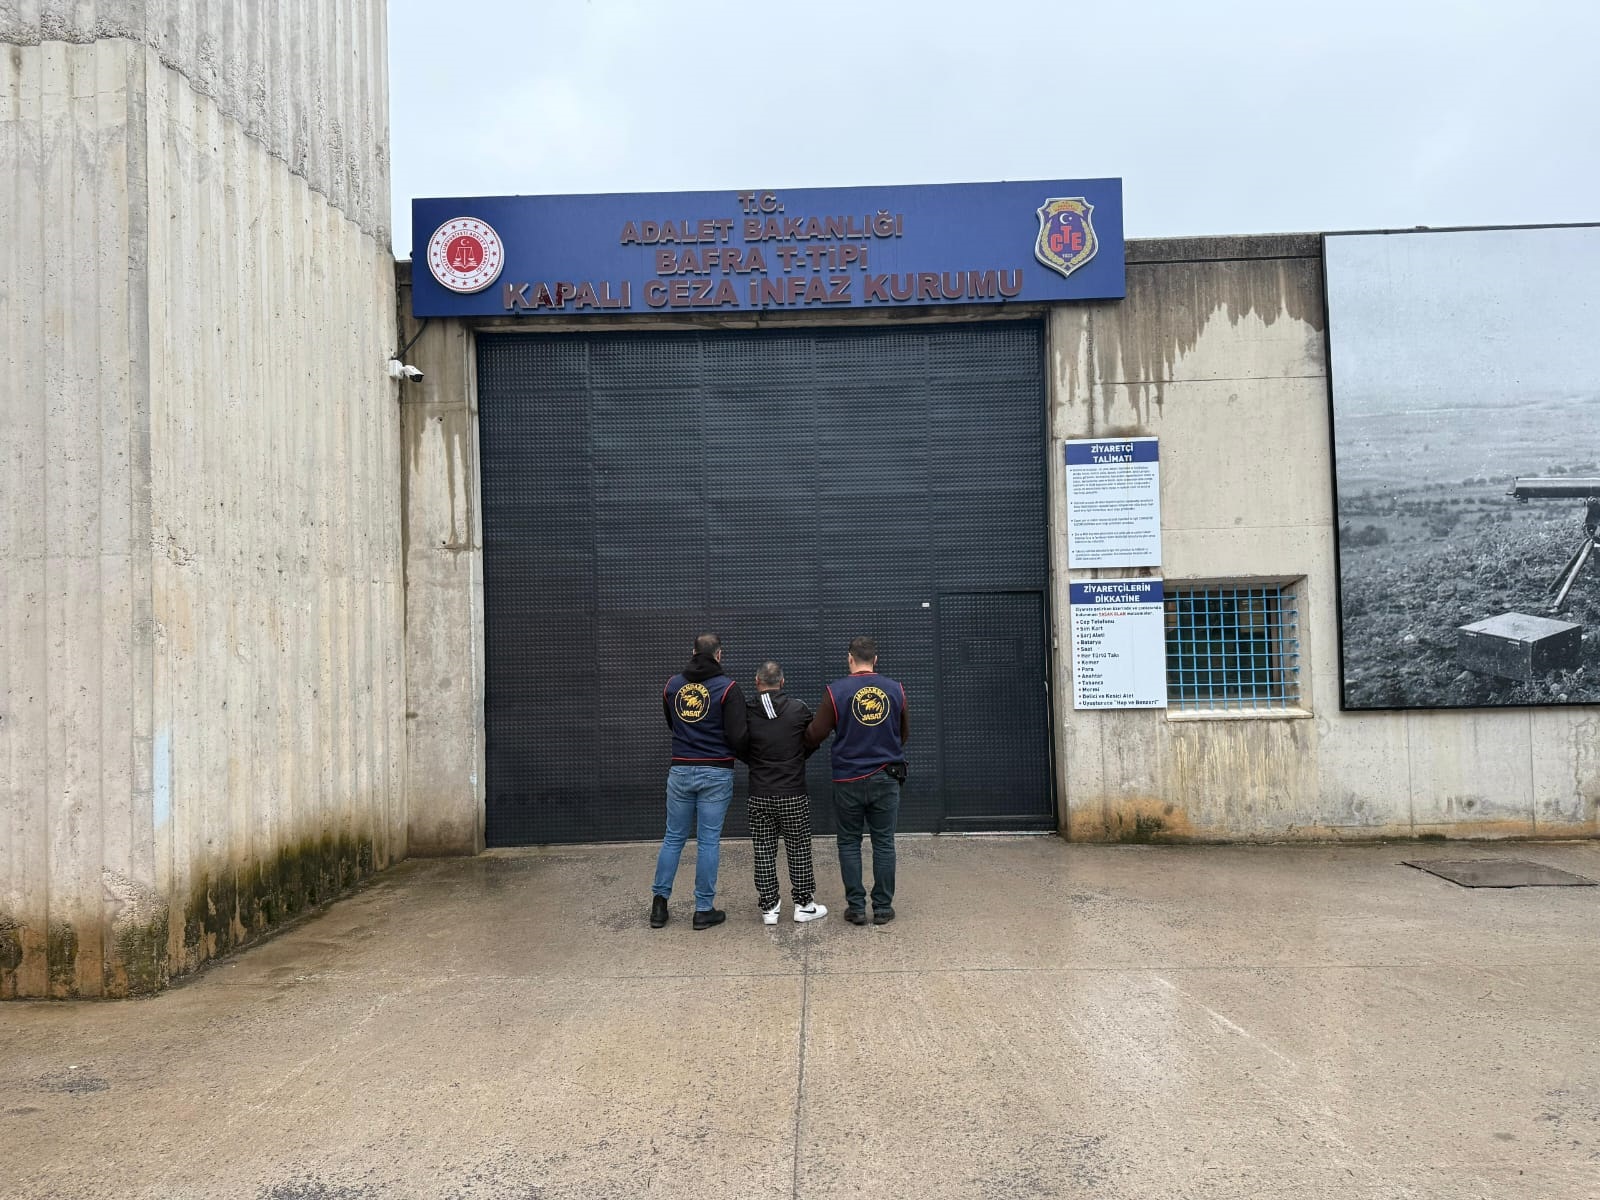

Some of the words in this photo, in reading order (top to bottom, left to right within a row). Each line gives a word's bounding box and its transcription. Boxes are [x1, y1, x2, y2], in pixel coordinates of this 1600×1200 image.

[738, 191, 784, 213] T.C.
[620, 218, 733, 244] ADALET
[743, 209, 903, 241] BAKANLIĞI
[656, 248, 767, 275] BAFRA
[504, 281, 631, 309] KAPALI
[644, 278, 739, 308] CEZA
[750, 275, 852, 305] İNFAZ
[864, 269, 1024, 301] KURUMU
[1091, 442, 1134, 453] ZİYARETÇİ
[1093, 454, 1132, 463] TALİMATI
[1084, 583, 1151, 593] ZİYARETÇİLERİN
[1095, 594, 1140, 603] DİKKATİNE
[681, 710, 701, 718] JASAT
